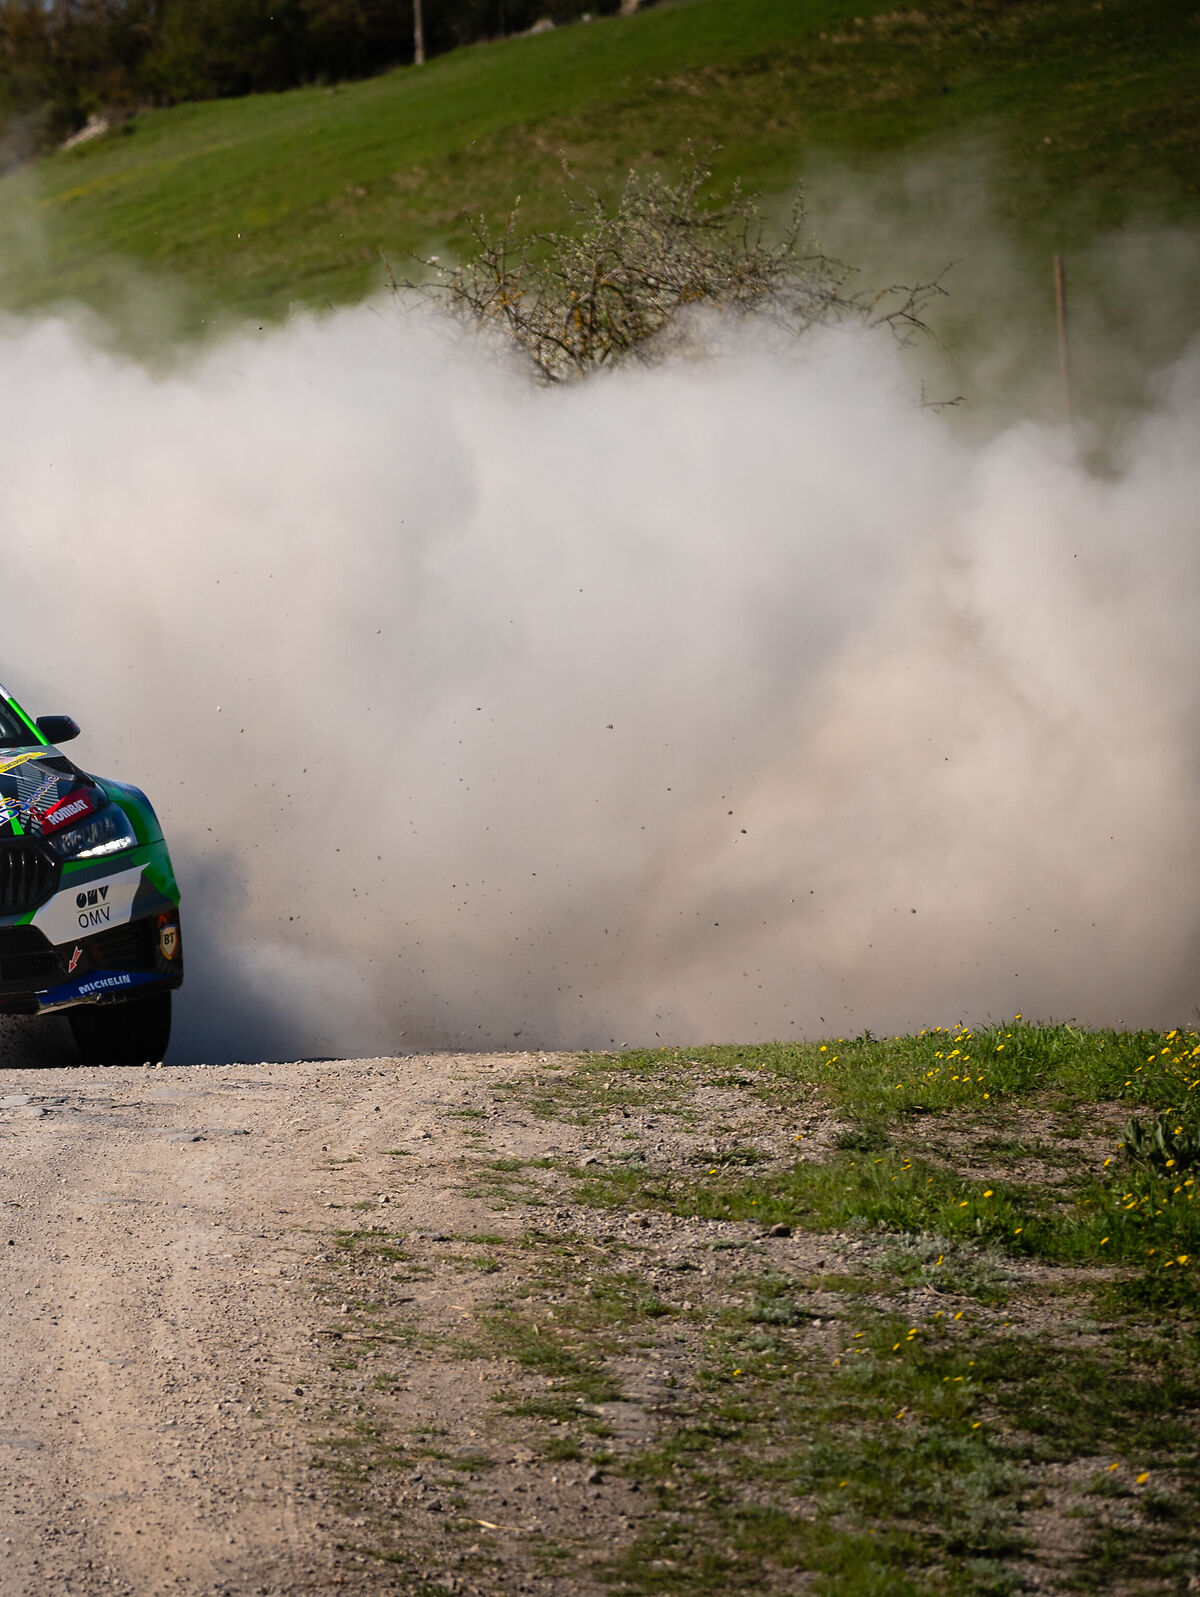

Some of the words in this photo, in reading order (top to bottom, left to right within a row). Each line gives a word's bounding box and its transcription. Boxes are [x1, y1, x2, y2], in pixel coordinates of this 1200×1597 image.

[47, 799, 90, 826] ROMBAT
[78, 907, 110, 928] OMV
[163, 932, 175, 944] BT
[78, 974, 131, 995] MICHELIN
